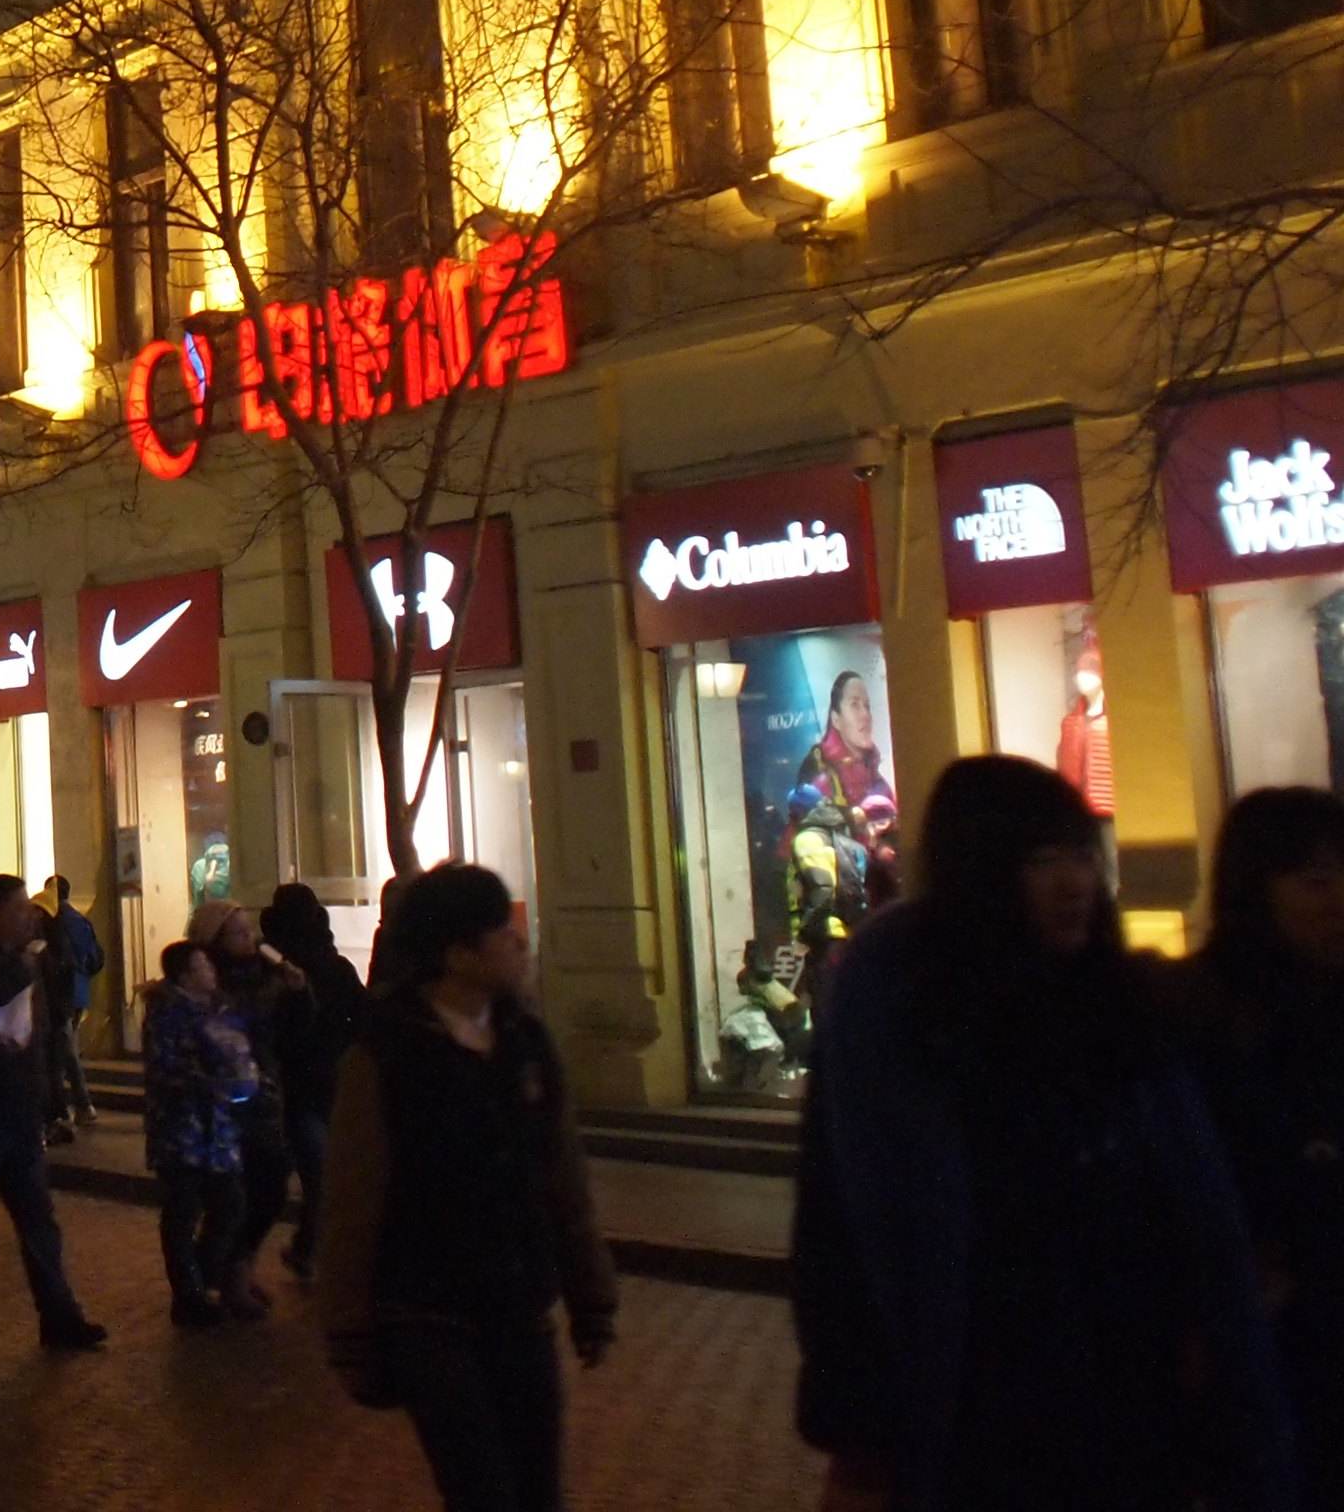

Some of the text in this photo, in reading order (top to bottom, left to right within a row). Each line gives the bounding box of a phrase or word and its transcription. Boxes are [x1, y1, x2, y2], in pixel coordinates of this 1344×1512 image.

[1220, 441, 1335, 504] Jack
[982, 487, 1024, 514] THE
[956, 509, 1023, 542] NORTH
[676, 520, 850, 591] Columbia
[976, 534, 1028, 563] FACE
